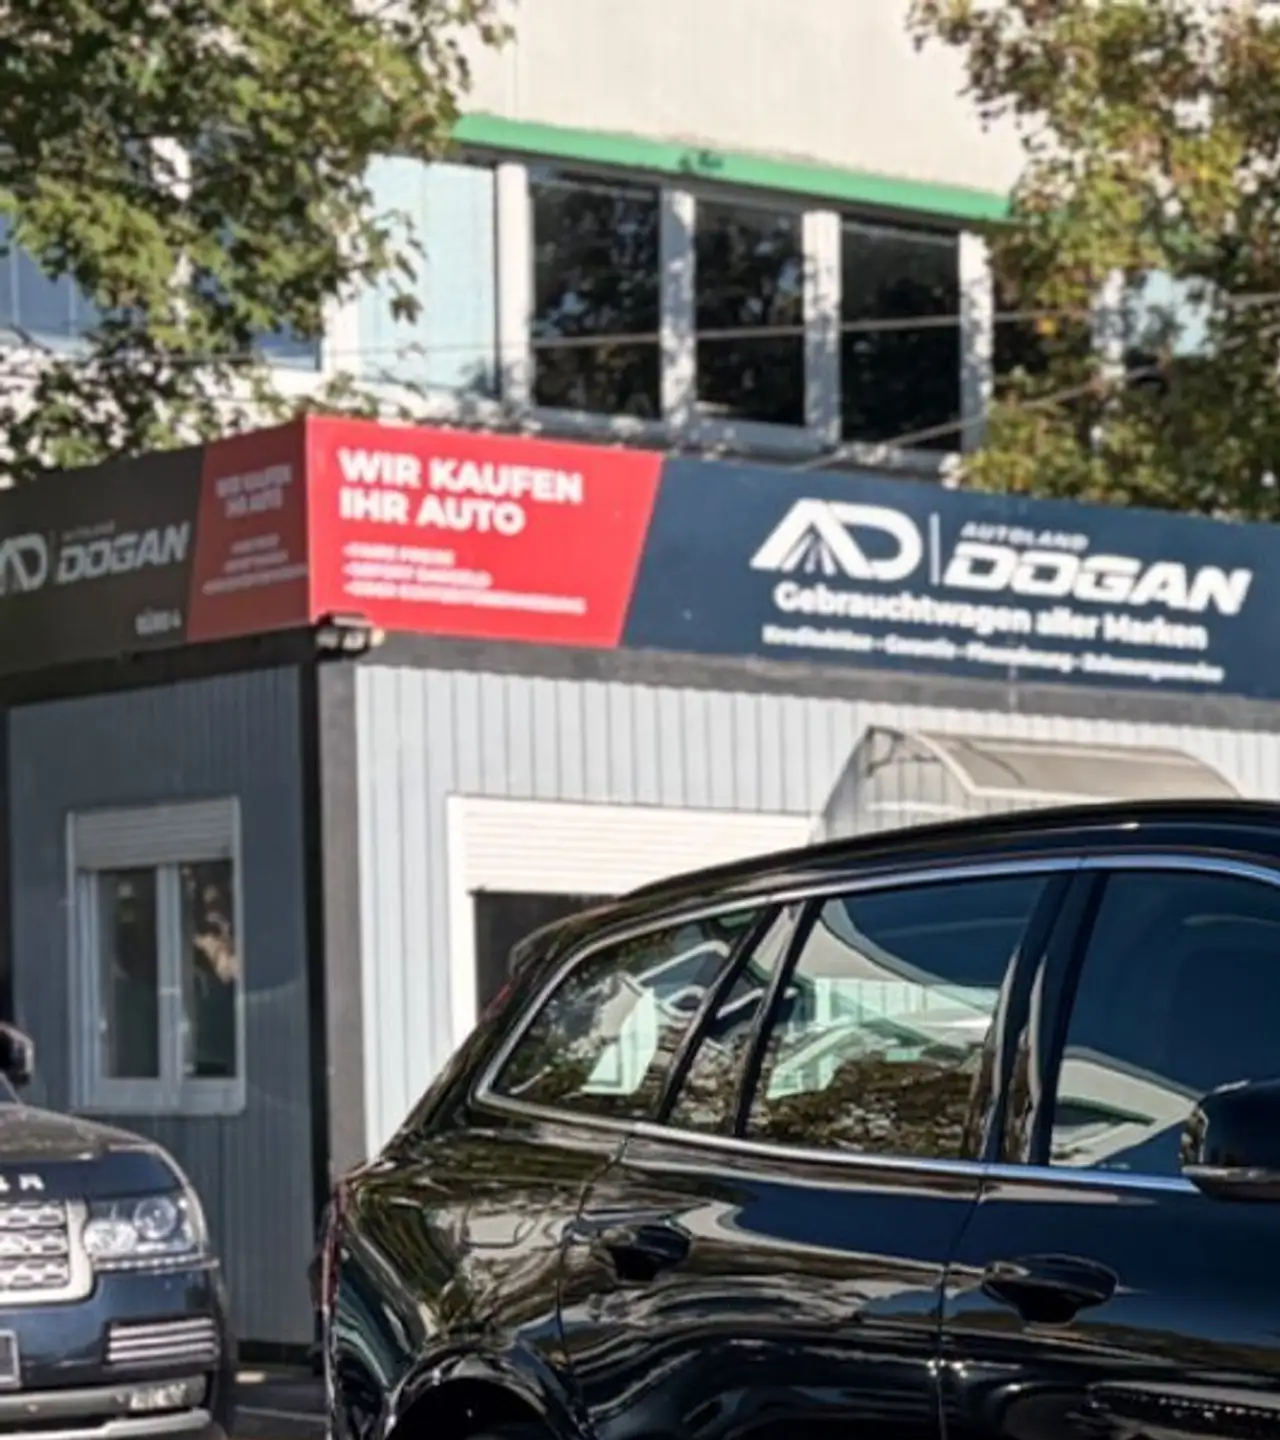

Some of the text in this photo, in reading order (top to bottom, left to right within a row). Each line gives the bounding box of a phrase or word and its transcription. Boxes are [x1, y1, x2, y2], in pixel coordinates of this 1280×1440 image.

[337, 449, 583, 503] WIR KAUFEN
[340, 488, 525, 535] IHR AUTO
[56, 520, 190, 585] DOGAN
[943, 542, 1253, 615] DOGAN
